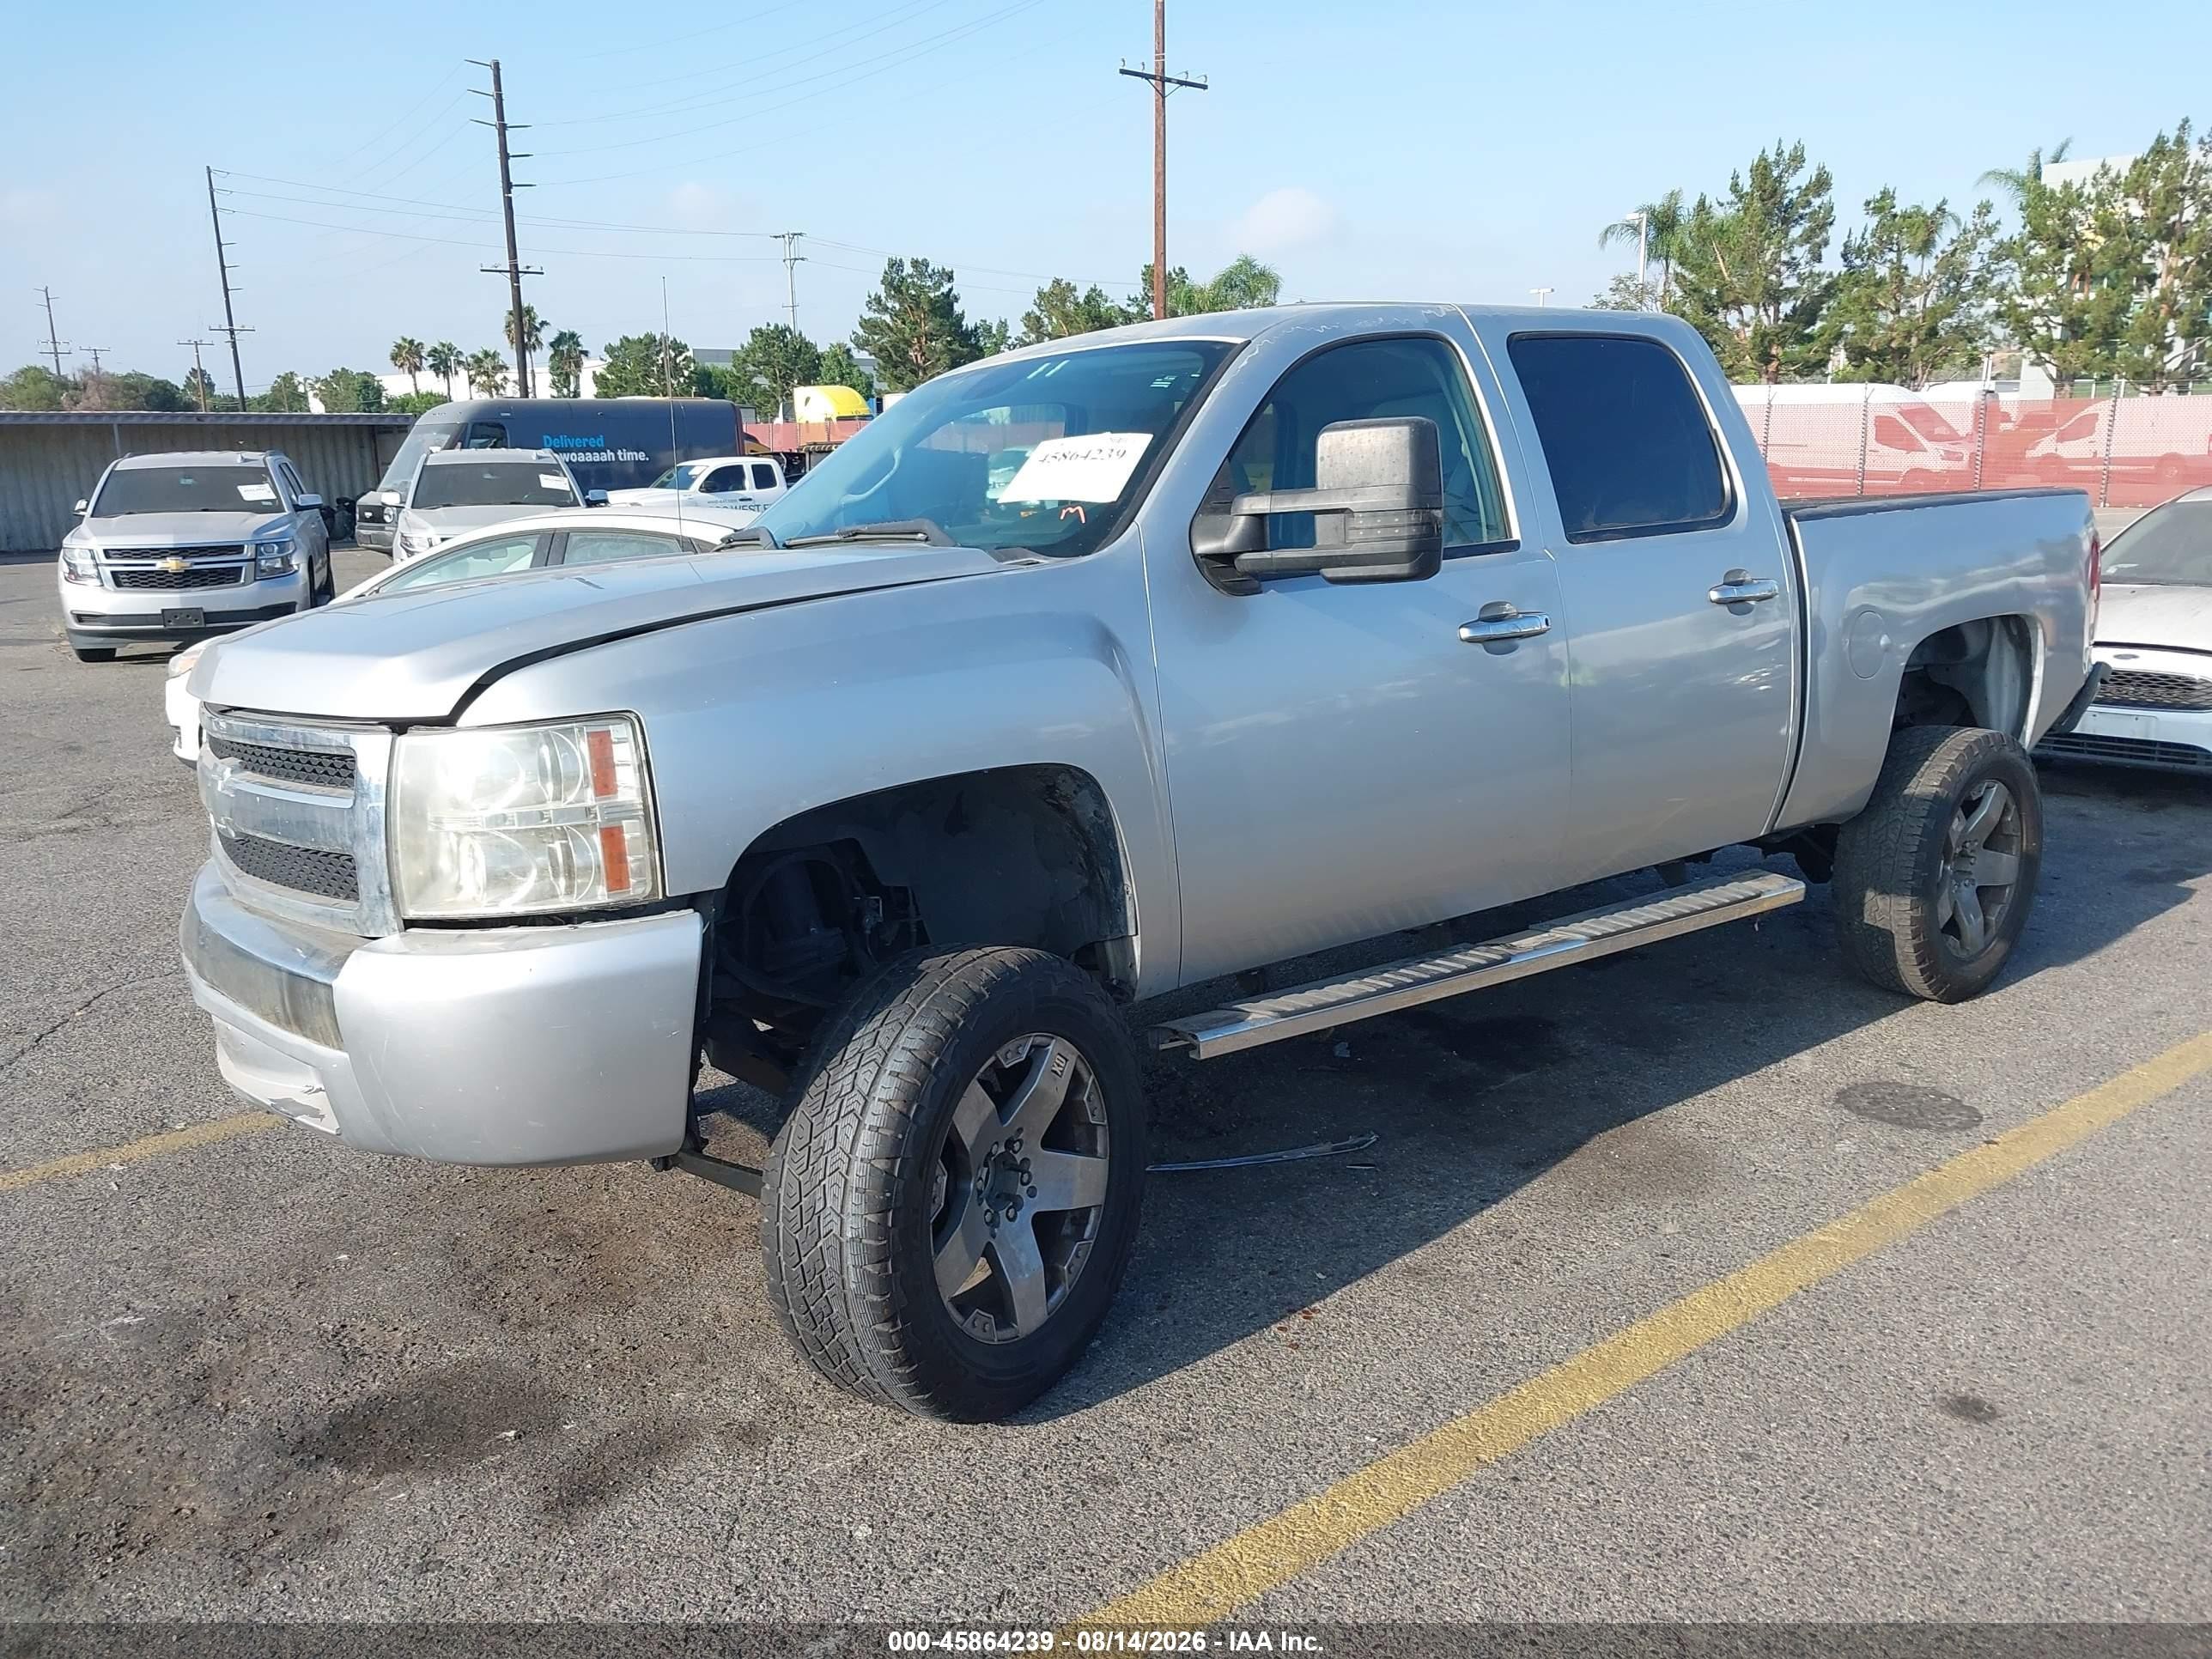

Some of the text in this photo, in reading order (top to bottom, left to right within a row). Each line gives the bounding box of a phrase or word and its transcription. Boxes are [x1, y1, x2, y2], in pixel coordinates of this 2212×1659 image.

[543, 434, 605, 447] Delivered
[617, 448, 650, 461] time.
[1038, 447, 1127, 463] 45864239
